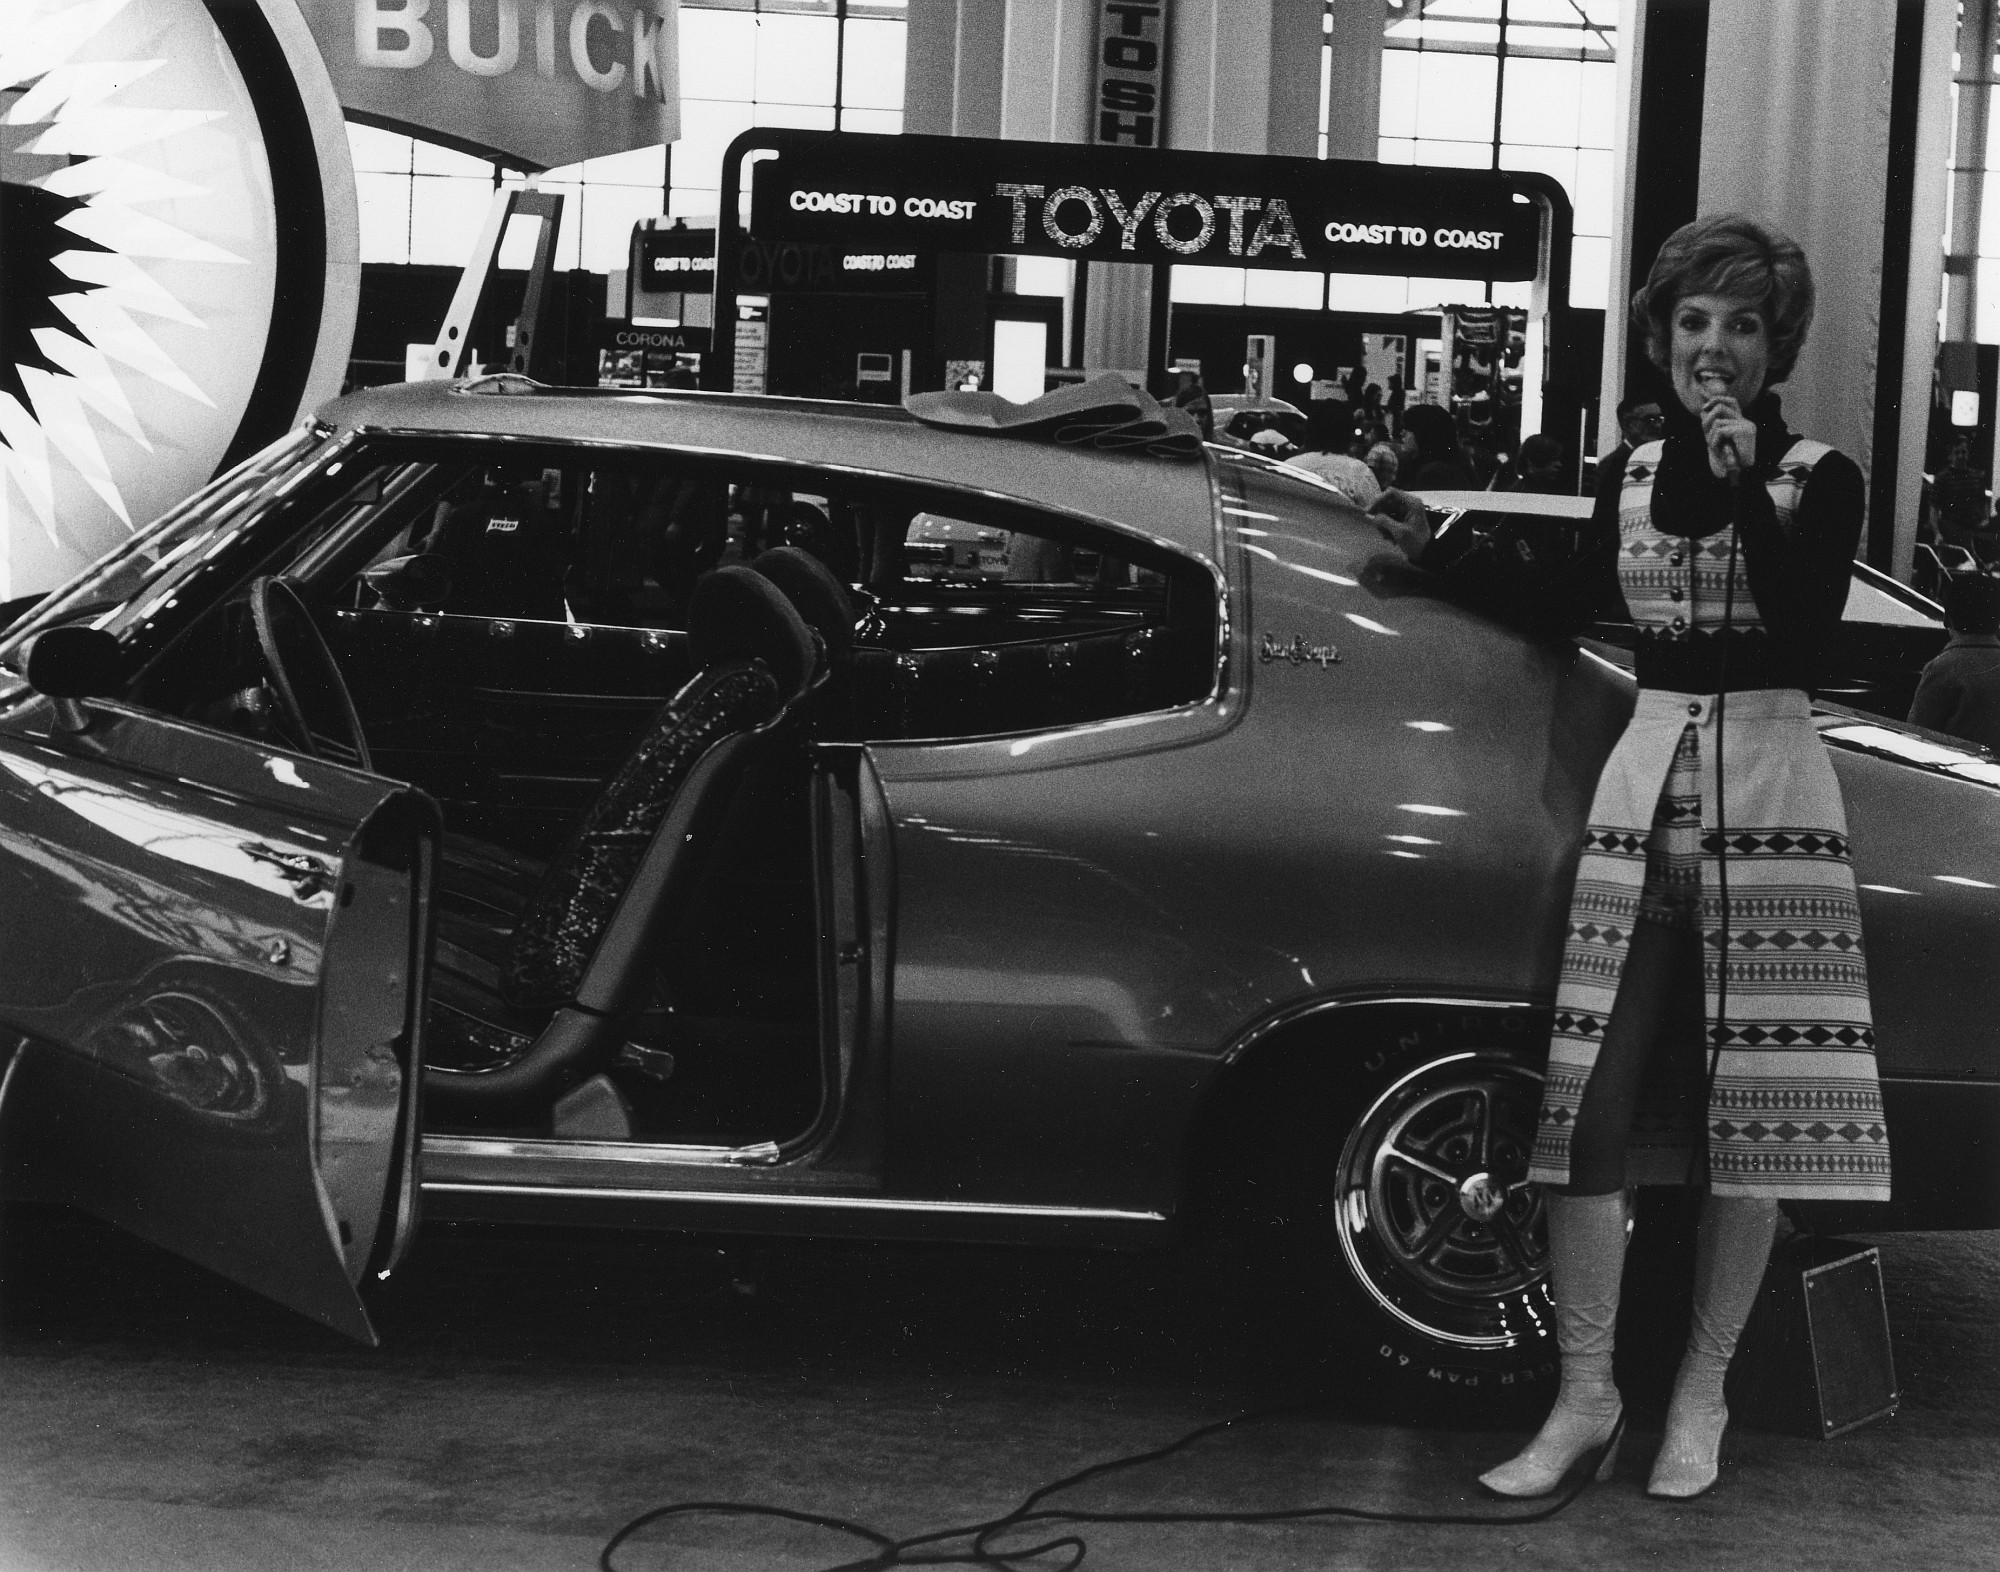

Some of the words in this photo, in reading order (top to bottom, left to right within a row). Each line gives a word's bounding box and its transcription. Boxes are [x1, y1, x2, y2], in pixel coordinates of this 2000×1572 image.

[355, 0, 664, 101] BUICK
[1100, 0, 1160, 146] TOSH
[790, 190, 864, 214] COAST
[866, 195, 896, 216] TO
[903, 198, 976, 220] COAST
[995, 182, 1306, 260] TOYOTA
[1325, 222, 1396, 245] COAST
[1397, 226, 1427, 246] TO
[1434, 228, 1504, 250] COAST
[886, 254, 916, 269] COAST
[616, 331, 685, 347] CORONA
[1380, 1344, 1410, 1366] 60
[1428, 1367, 1478, 1386] PAW
